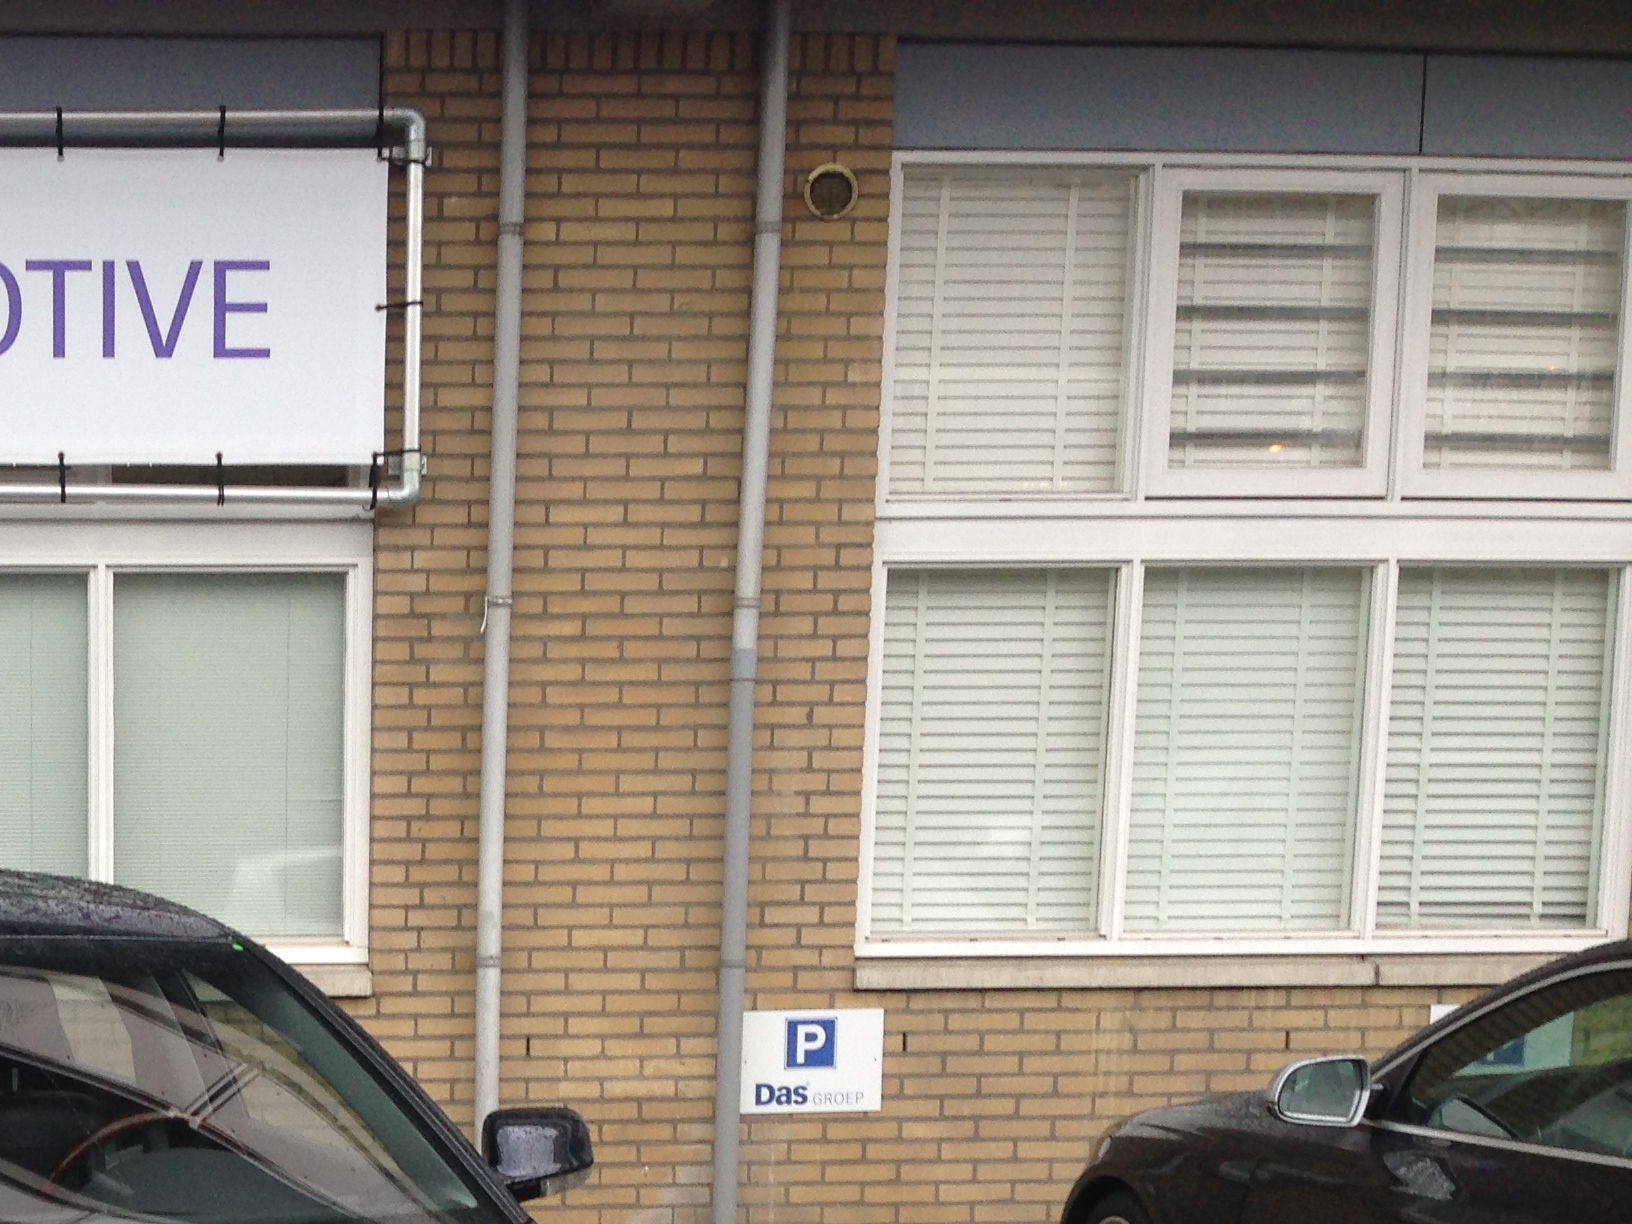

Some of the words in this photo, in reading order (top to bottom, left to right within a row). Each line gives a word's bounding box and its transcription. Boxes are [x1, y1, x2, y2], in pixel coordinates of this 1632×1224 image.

[796, 1023, 826, 1064] P
[755, 1082, 808, 1106] Das
[812, 1091, 865, 1106] GROEP
